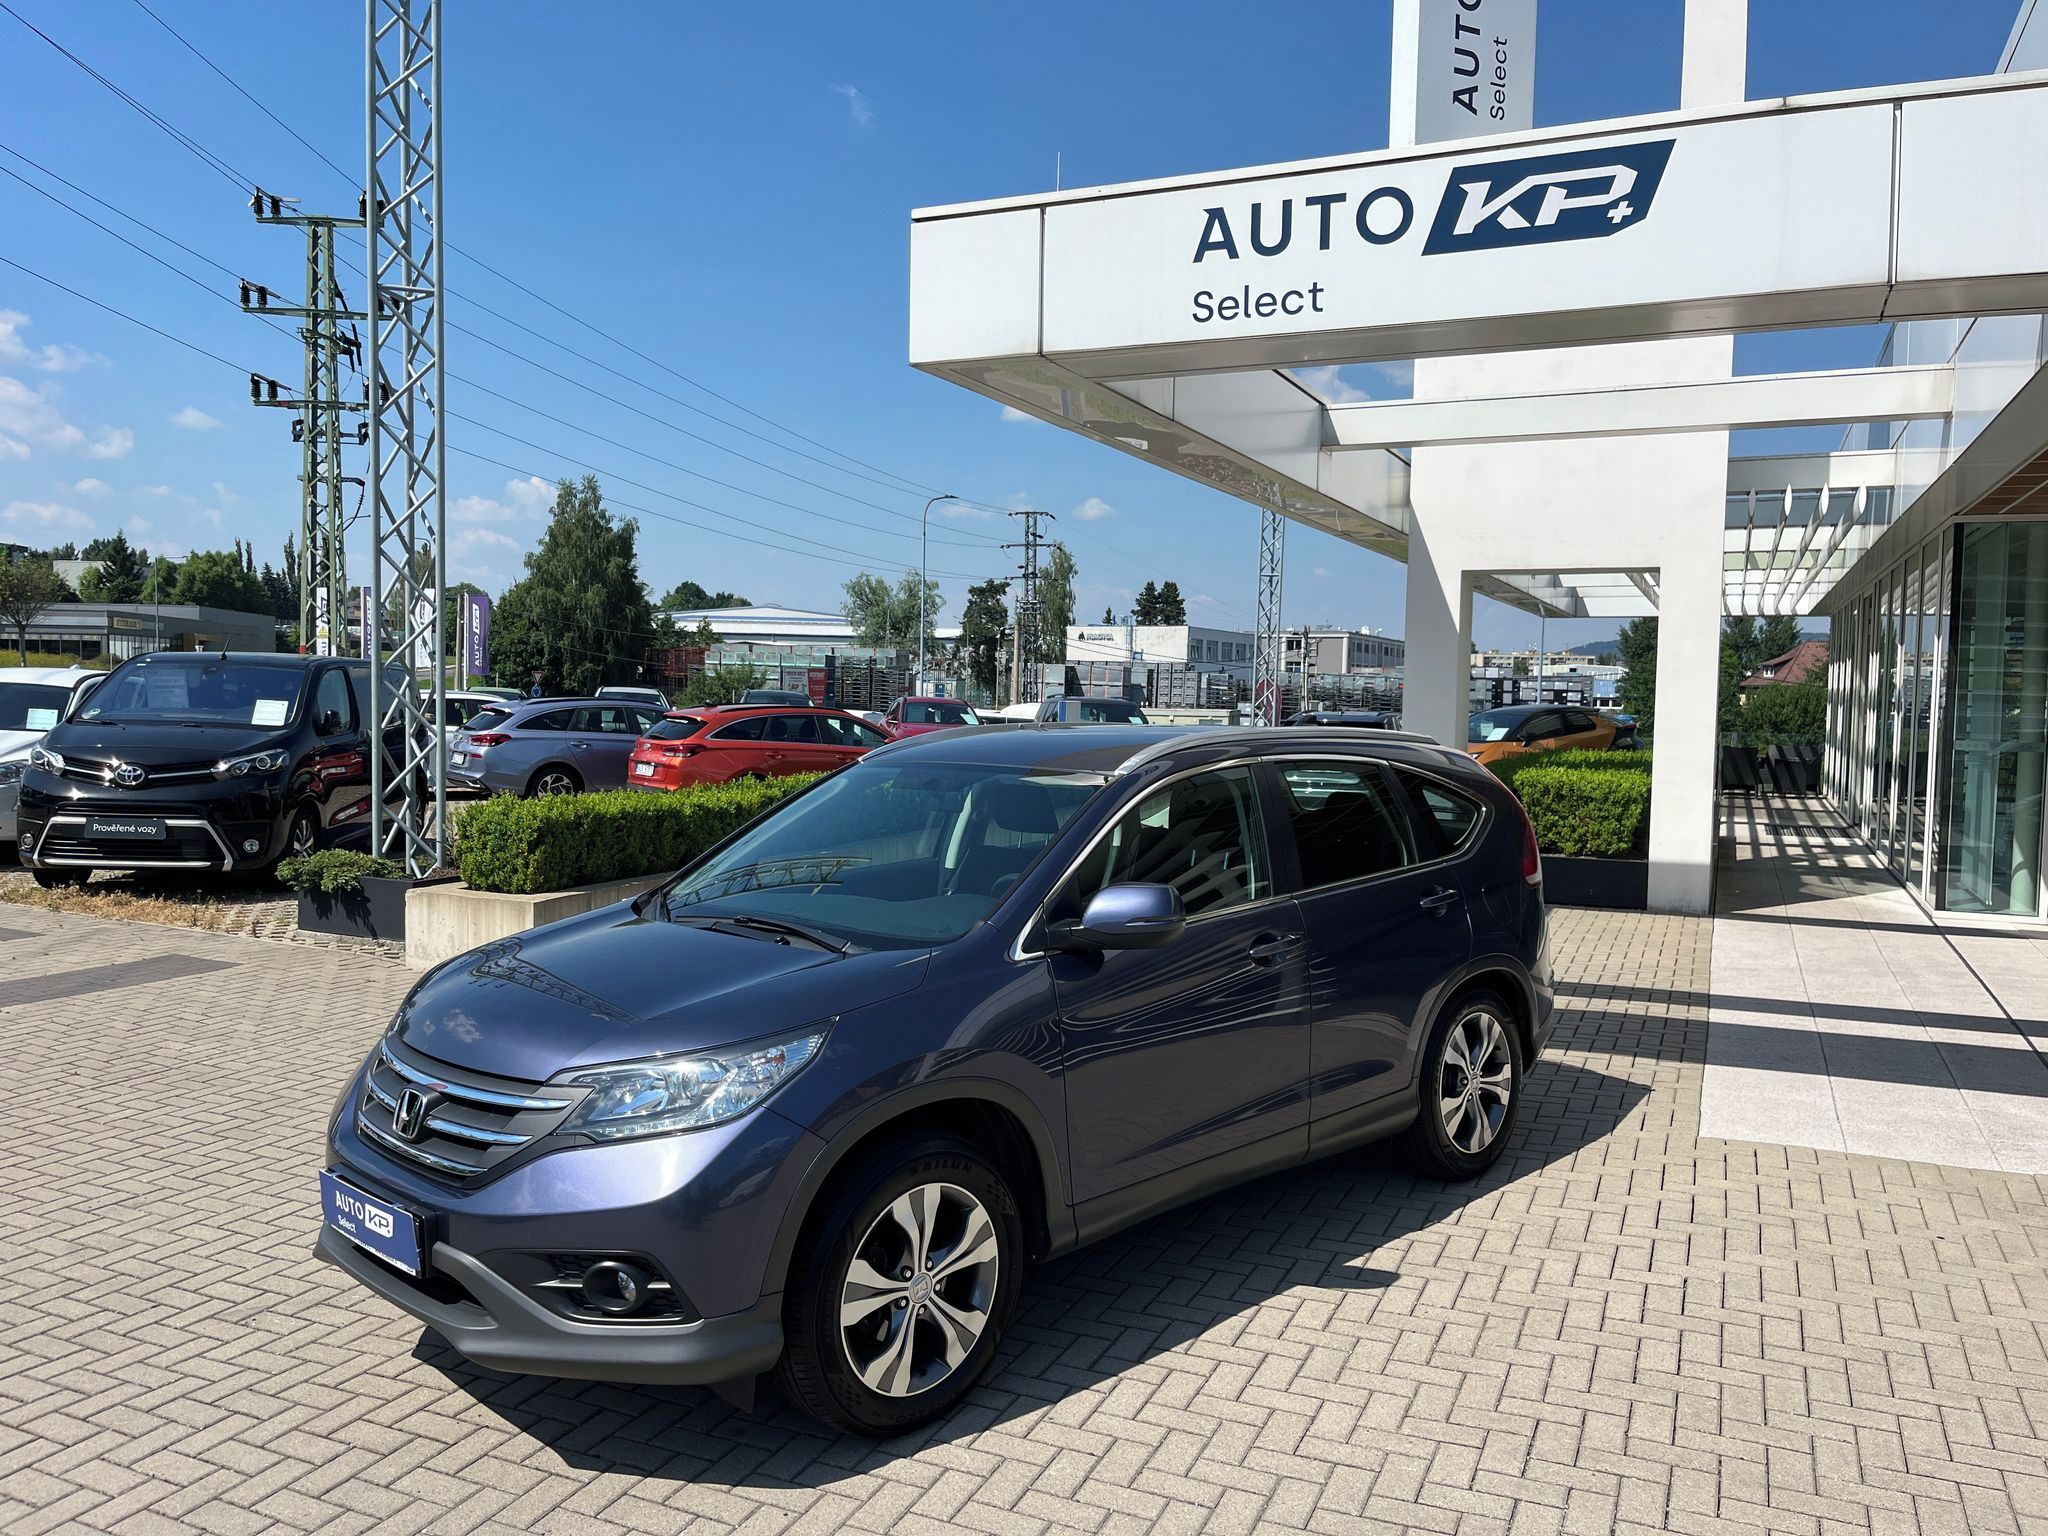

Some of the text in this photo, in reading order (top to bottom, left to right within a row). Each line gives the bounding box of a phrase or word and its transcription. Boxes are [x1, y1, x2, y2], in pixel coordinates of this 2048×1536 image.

[1489, 36, 1508, 121] Select
[1192, 186, 1414, 263] AUTO
[1192, 282, 1324, 323] Select
[93, 823, 157, 835] Prověřené vozy
[336, 1190, 364, 1220] AUTO
[338, 1214, 357, 1234] Select
